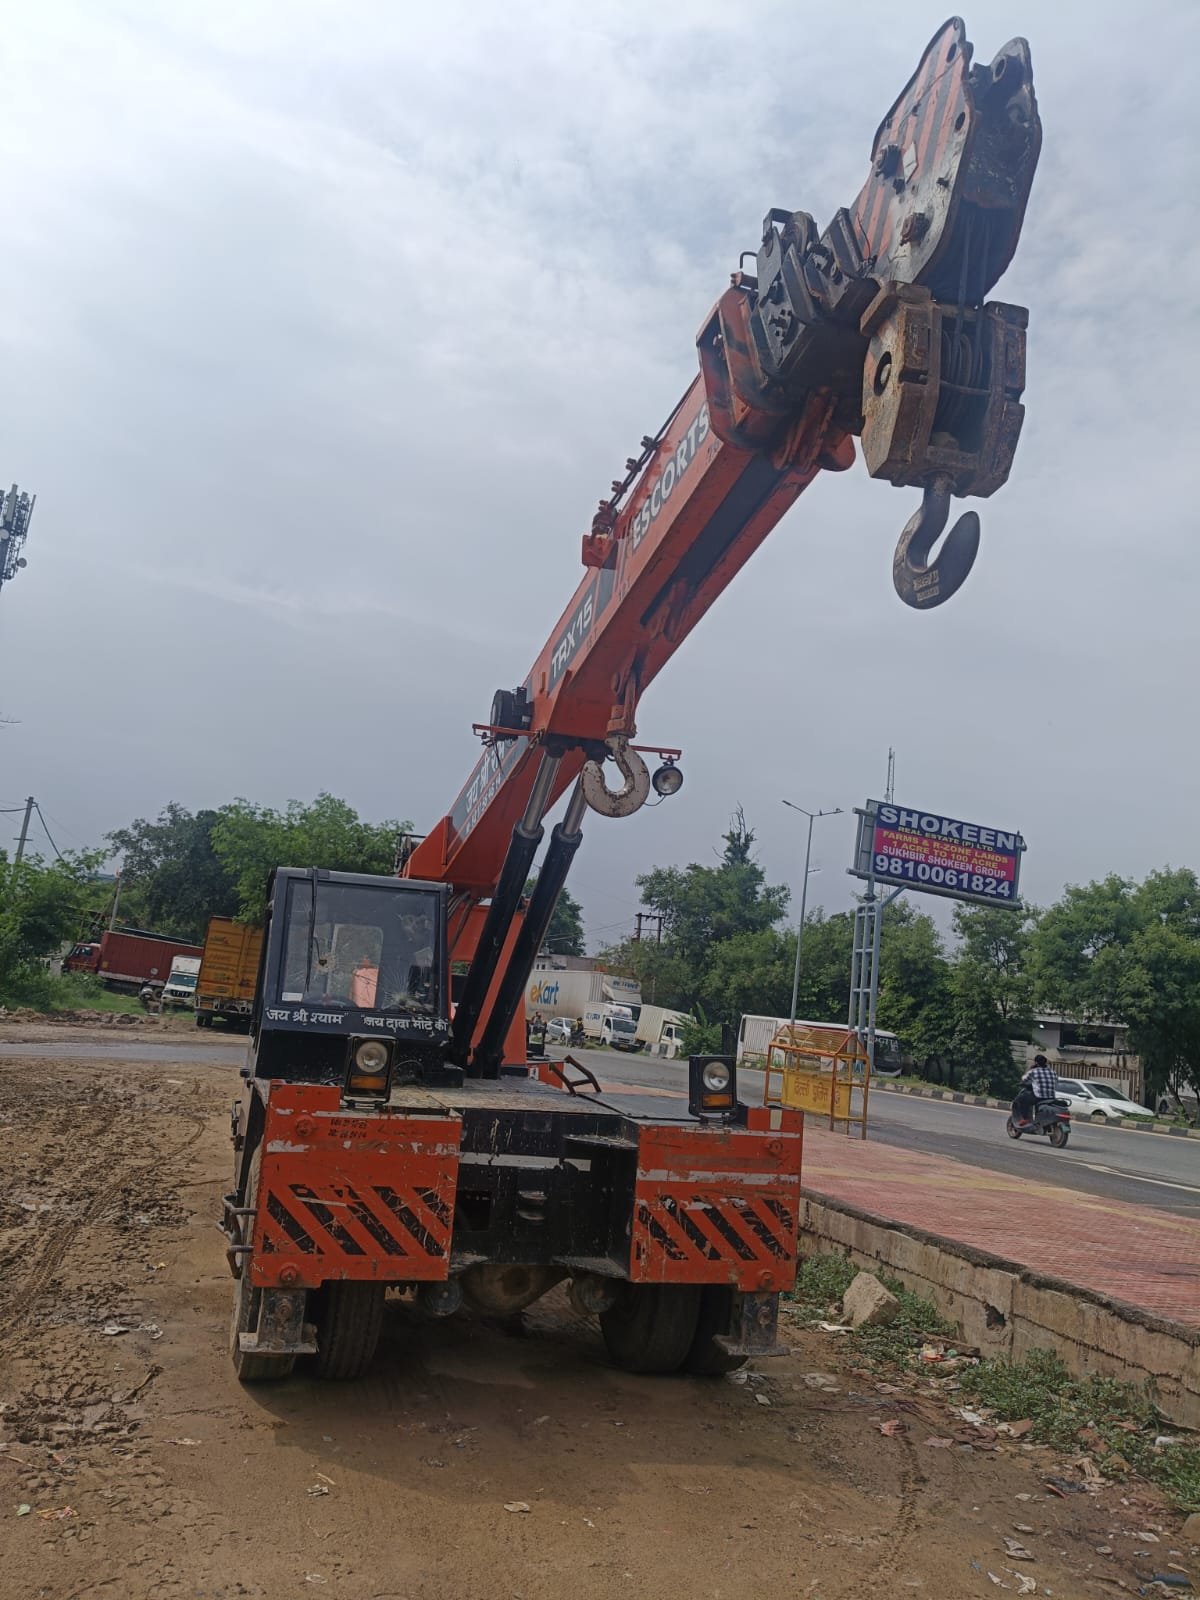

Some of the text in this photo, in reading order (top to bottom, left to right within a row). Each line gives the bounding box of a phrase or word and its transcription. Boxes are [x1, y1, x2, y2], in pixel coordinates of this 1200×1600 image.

[632, 401, 710, 549] ESCORTS
[551, 594, 593, 678] TRX 15
[880, 807, 1015, 850] SHOKEEN
[898, 826, 923, 836] REAL
[925, 832, 960, 844] ESTATE
[962, 841, 974, 849] (P)
[883, 831, 918, 844] FARMS
[933, 842, 972, 856] R-ZONE
[975, 851, 1008, 864] LANDS
[883, 845, 1006, 879] SUKHBIR SHOKEEN GROUP
[902, 843, 930, 854] ACRE
[934, 849, 947, 858] TO
[951, 853, 968, 862] 100
[971, 858, 999, 869] ACRE
[875, 855, 1010, 897] 9810061824
[292, 1008, 309, 1026] श्री
